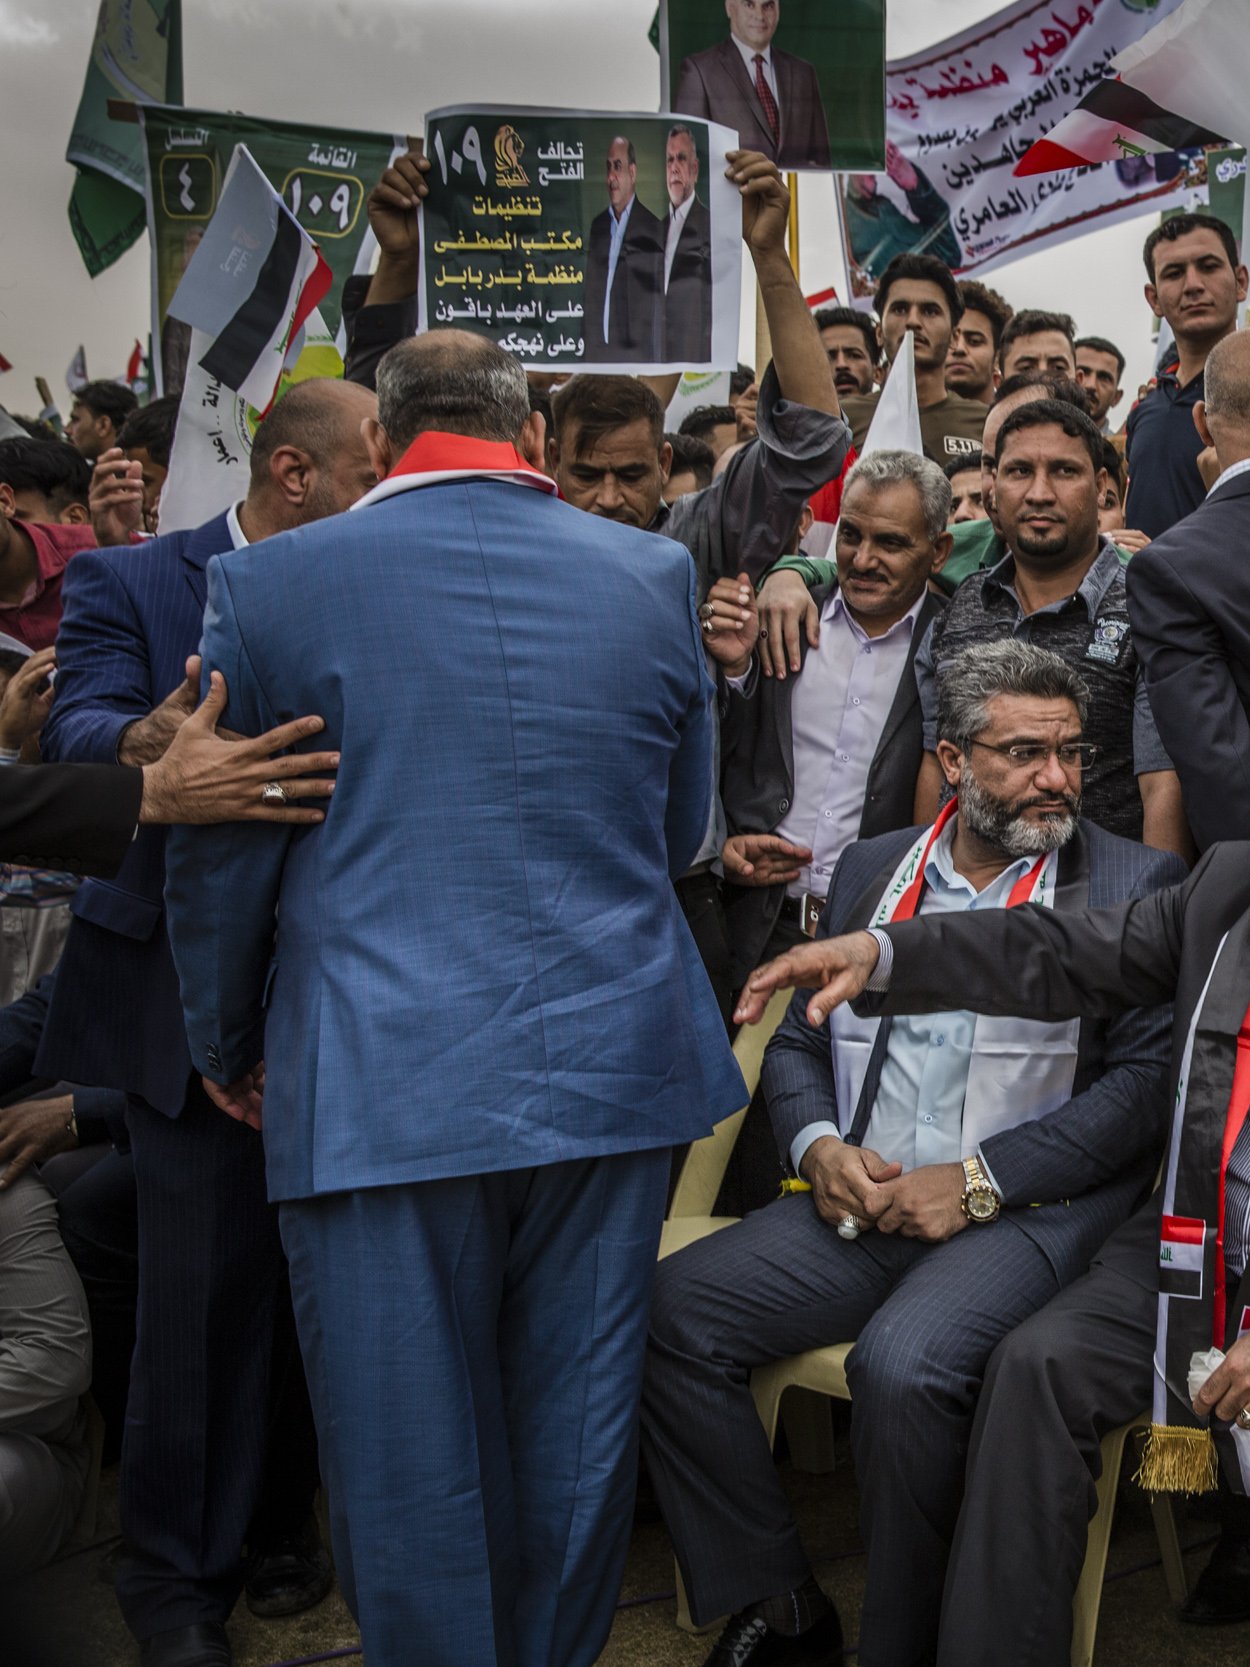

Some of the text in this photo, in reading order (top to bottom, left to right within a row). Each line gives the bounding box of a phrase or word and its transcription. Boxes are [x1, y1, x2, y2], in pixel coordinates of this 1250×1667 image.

[1022, 0, 1103, 76] ماهير
[307, 143, 357, 169] القائمة
[434, 125, 488, 187] ١٠٩
[537, 141, 584, 160] تحالف
[538, 162, 585, 187] الفتح
[291, 176, 351, 231] ١٠٩
[472, 195, 543, 221] تنظيمات
[954, 186, 1029, 242] العامري
[434, 229, 583, 255] مكتب المصطفى
[434, 262, 584, 291] منظمة بدر بابل
[435, 297, 585, 325] على العهد باقون
[547, 333, 585, 357] وعلى
[948, 439, 973, 453] 5.11
